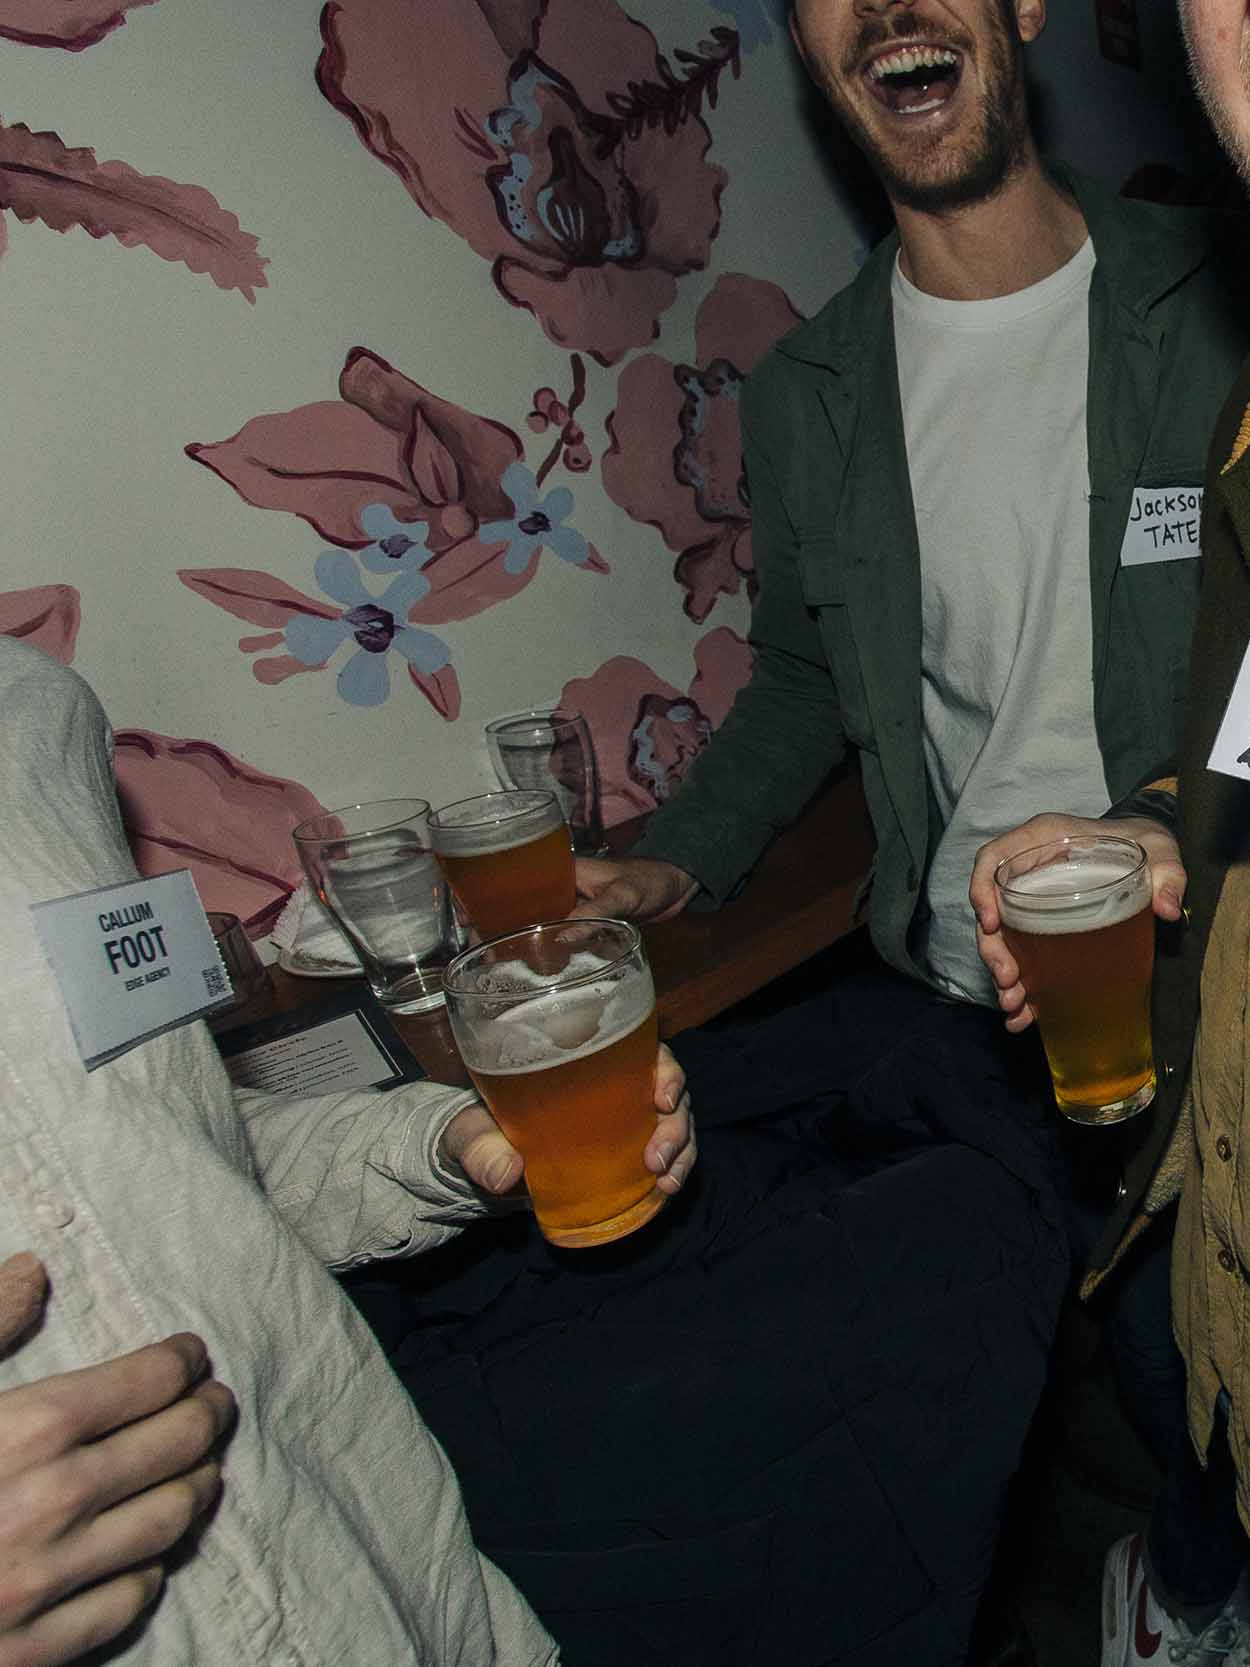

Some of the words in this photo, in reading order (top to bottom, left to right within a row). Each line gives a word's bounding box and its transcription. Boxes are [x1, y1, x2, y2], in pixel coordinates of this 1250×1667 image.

[1130, 493, 1201, 521] Jackso
[1143, 520, 1198, 548] TATE
[98, 902, 154, 932] CALLUM
[104, 925, 168, 974] FOOT
